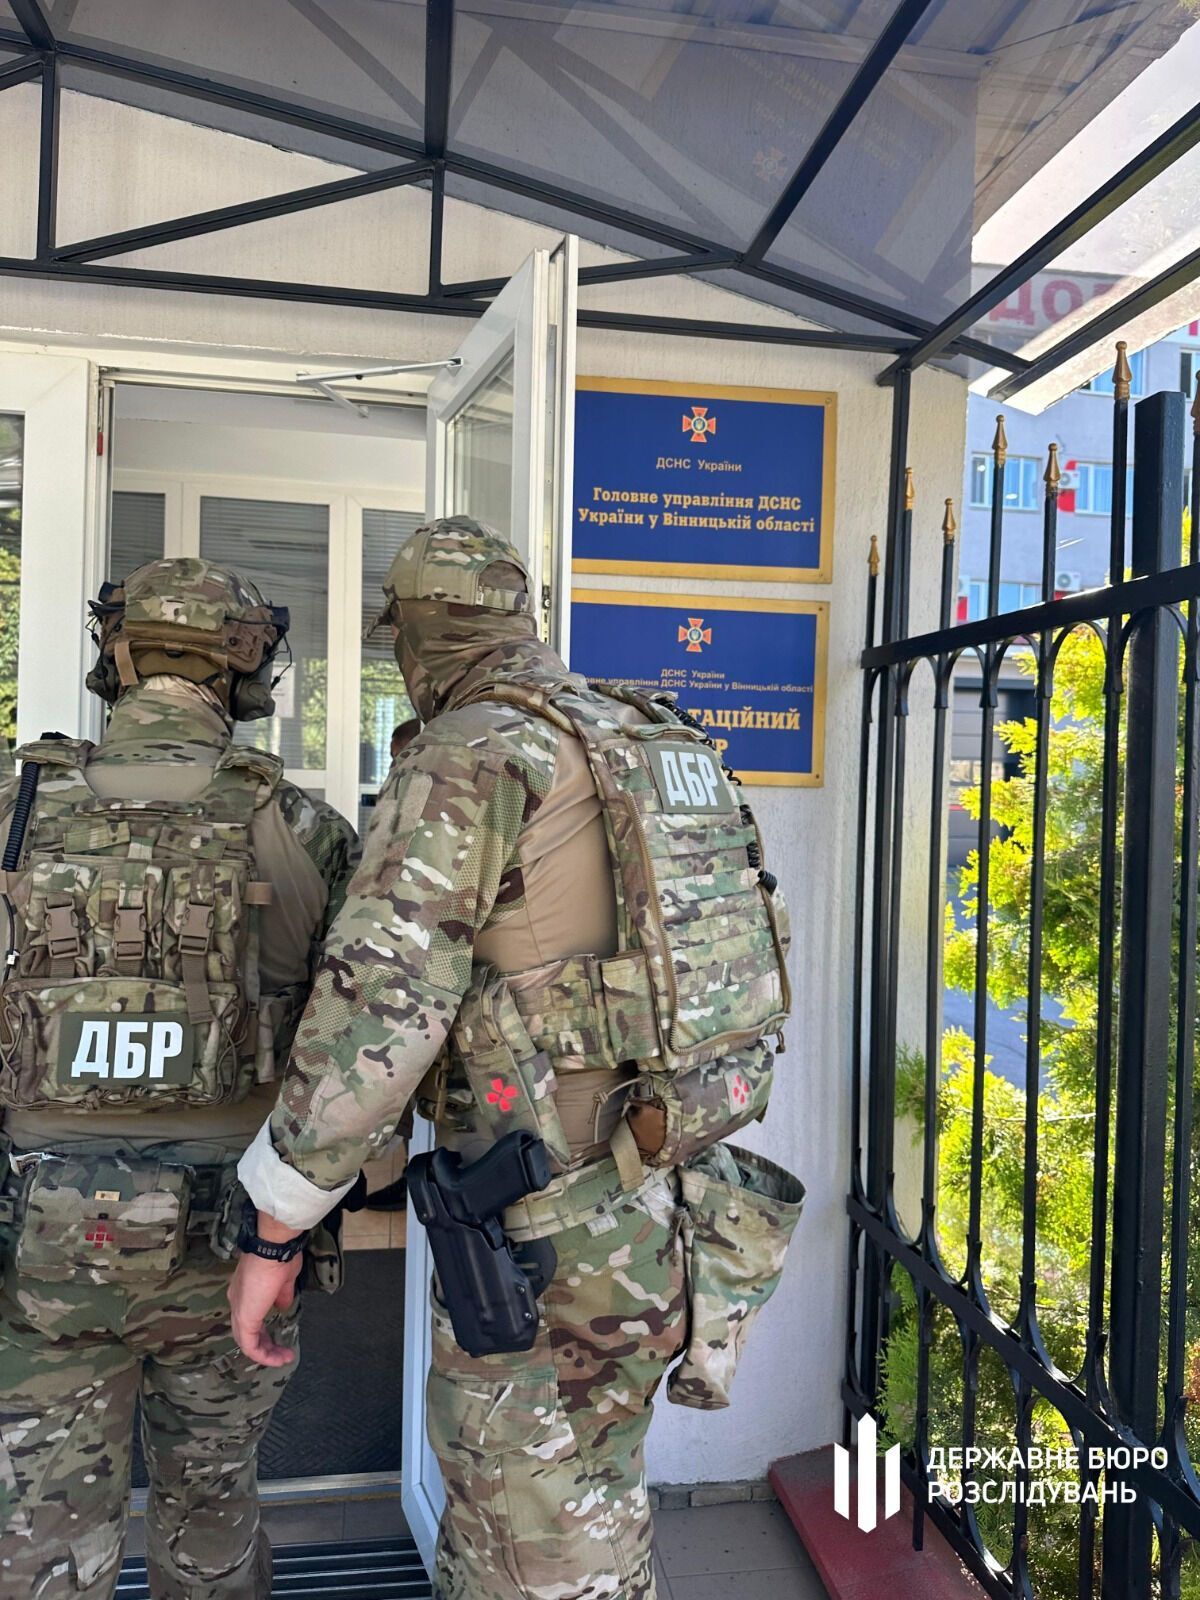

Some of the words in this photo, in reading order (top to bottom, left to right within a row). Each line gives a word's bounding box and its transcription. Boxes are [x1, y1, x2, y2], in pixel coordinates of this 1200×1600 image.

[656, 457, 691, 470] ДСНС
[698, 459, 742, 472] України
[593, 487, 658, 504] Головне
[663, 491, 753, 509] управління
[758, 495, 801, 511] ДСНС
[578, 508, 644, 526] України
[648, 515, 658, 529] у
[663, 512, 751, 530] Вінницькій
[756, 516, 815, 533] області
[608, 679, 659, 687] управління
[661, 679, 687, 689] ДСНС
[689, 681, 723, 690] України
[724, 683, 730, 691] у
[731, 682, 780, 692] Вінницькій
[781, 685, 813, 693] області
[661, 668, 687, 679] ДСНС
[692, 670, 725, 680] України
[688, 706, 801, 731] ТАЦІЙНИЙ
[660, 751, 719, 807] ДБР
[71, 1020, 184, 1078] ДБР
